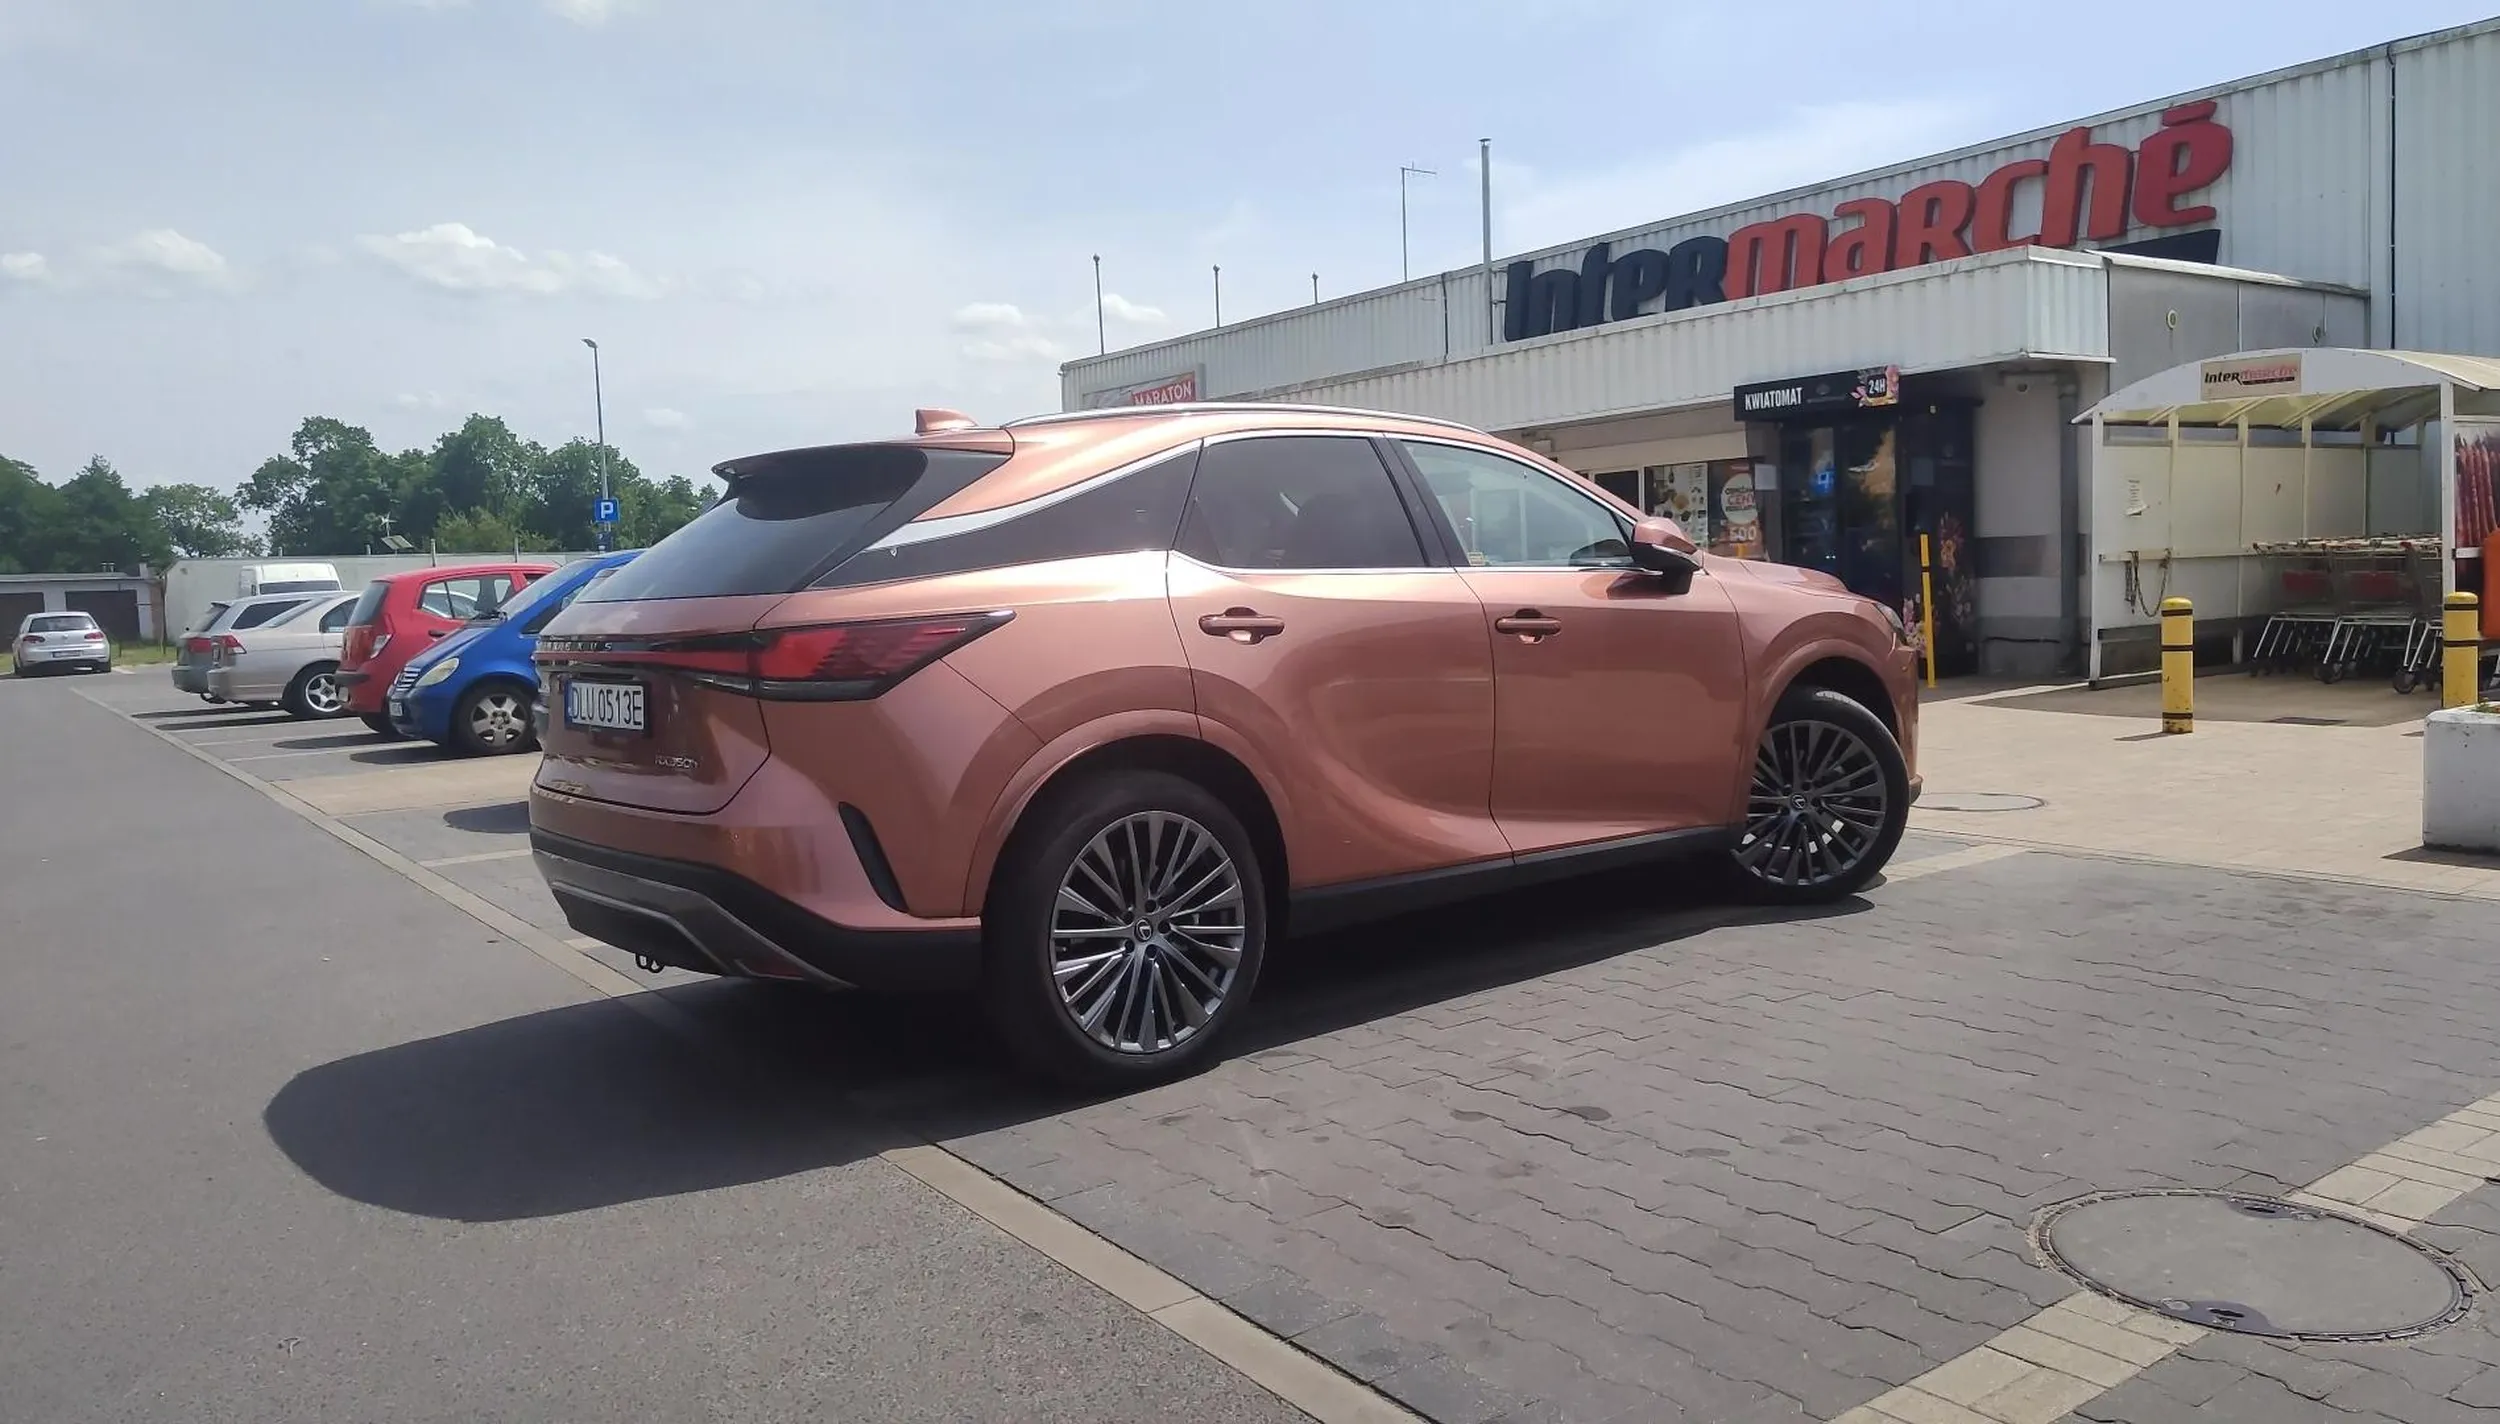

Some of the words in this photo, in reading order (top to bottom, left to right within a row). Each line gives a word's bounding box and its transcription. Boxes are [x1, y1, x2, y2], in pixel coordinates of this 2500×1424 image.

[1134, 381, 1192, 405] MARATON
[1868, 378, 1886, 394] 24H
[1745, 387, 1803, 411] KWIATOMAT
[600, 501, 614, 519] P
[572, 687, 594, 720] DLU
[598, 688, 643, 726] 0513E
